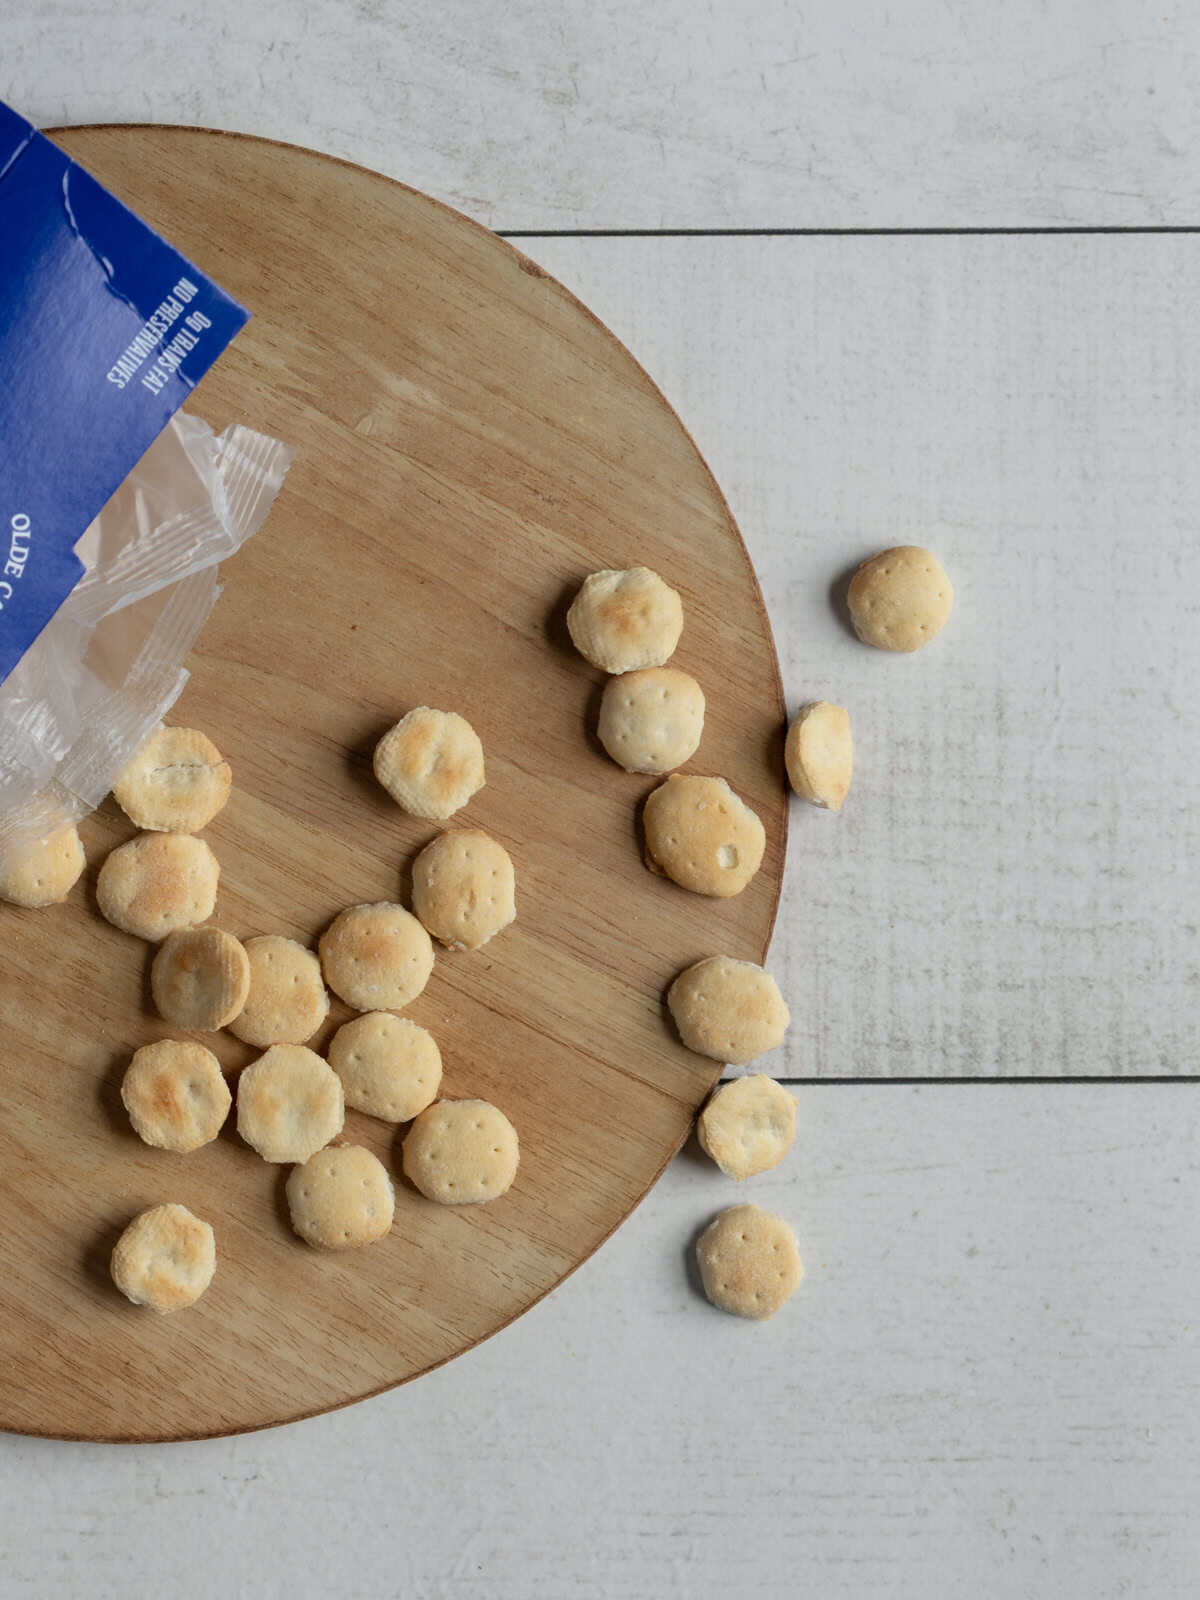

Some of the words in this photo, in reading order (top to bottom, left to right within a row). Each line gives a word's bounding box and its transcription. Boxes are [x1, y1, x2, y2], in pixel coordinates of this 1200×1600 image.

[172, 277, 199, 303] NO
[106, 295, 185, 389] PRESERVATIVES
[158, 327, 200, 373] TRANS
[141, 365, 169, 396] FAT
[3, 513, 31, 578] OLDE
